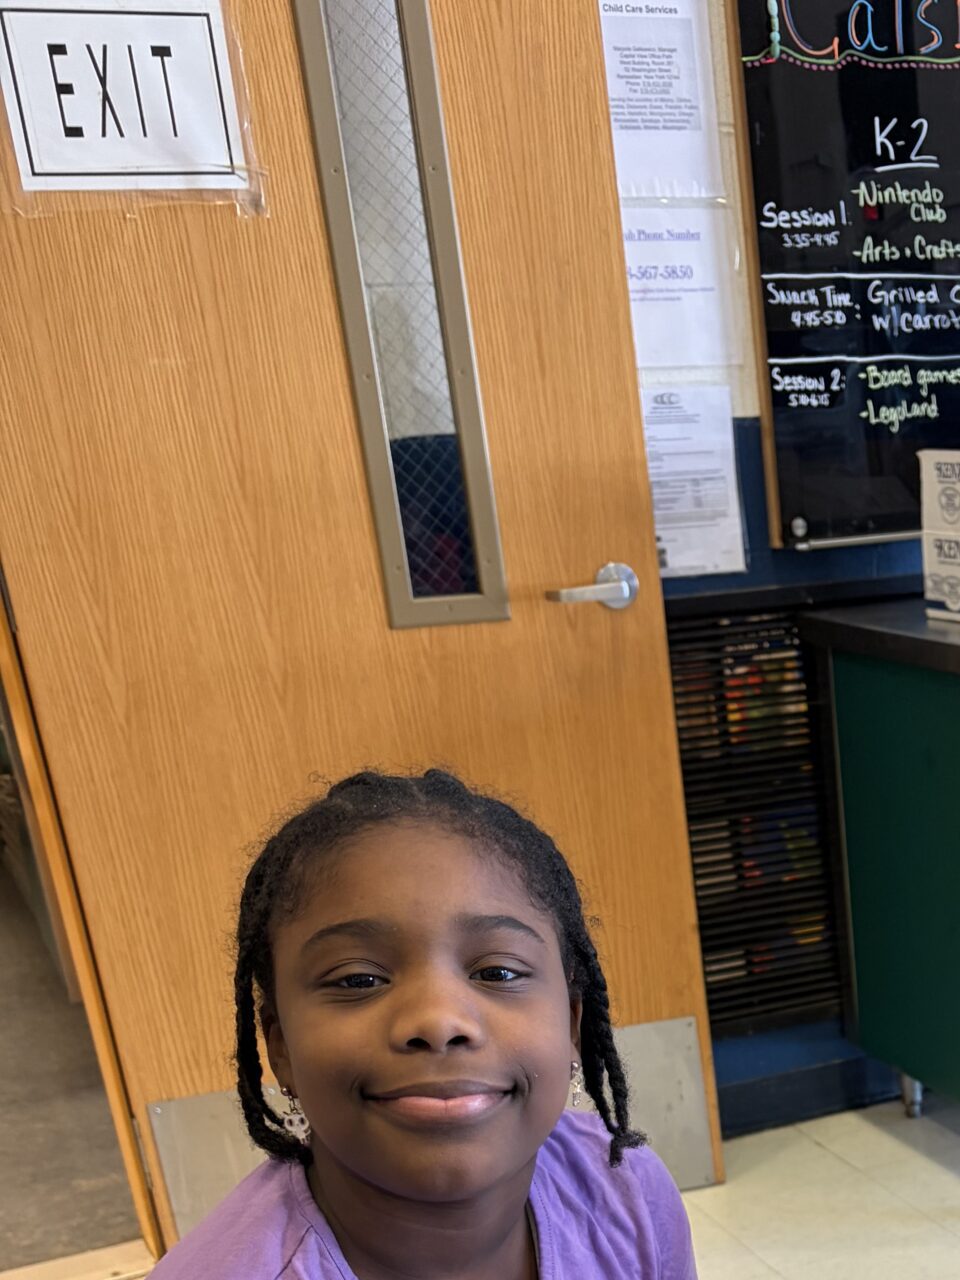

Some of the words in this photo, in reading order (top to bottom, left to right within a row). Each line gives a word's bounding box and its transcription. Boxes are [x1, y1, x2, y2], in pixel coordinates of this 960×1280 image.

[602, 3, 623, 13] Child
[625, 4, 643, 13] Care
[645, 5, 678, 14] Services
[47, 43, 178, 138] EXIT
[874, 116, 938, 160] K-2
[760, 201, 836, 229] Session
[911, 203, 947, 222] Club
[867, 280, 940, 305] Grilled
